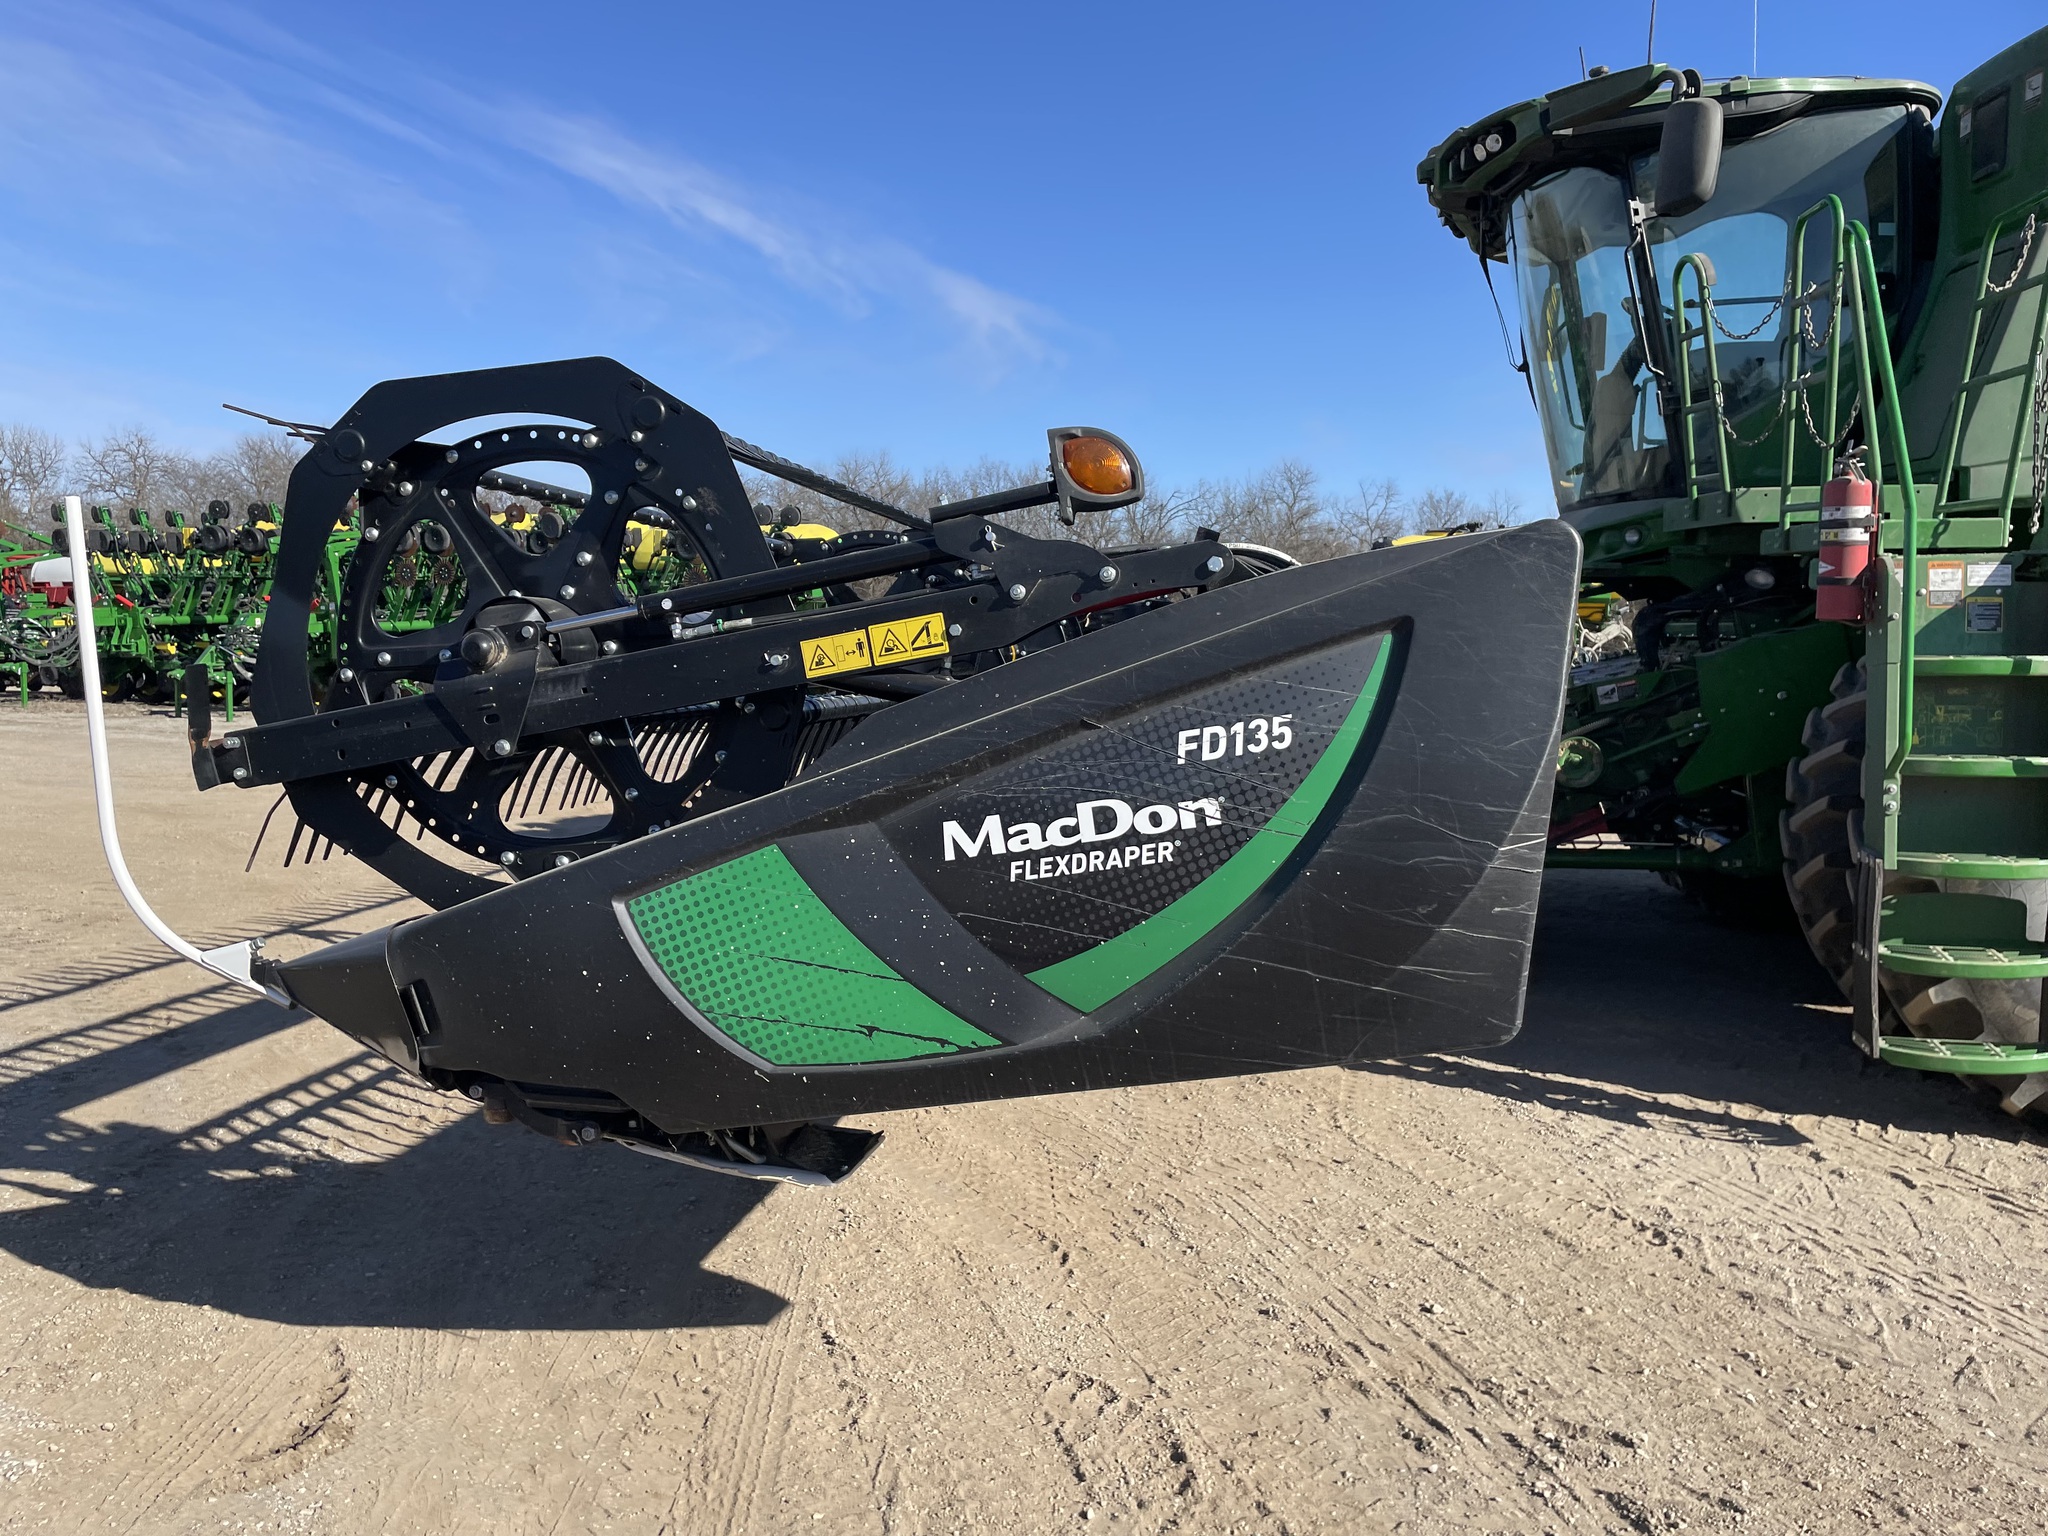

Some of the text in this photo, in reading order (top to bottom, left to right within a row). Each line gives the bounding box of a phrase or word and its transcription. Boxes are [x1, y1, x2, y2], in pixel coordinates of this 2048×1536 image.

[1177, 713, 1294, 765] FD135
[942, 797, 1223, 862] MacDon
[1009, 840, 1175, 883] FLEXDRAPER
